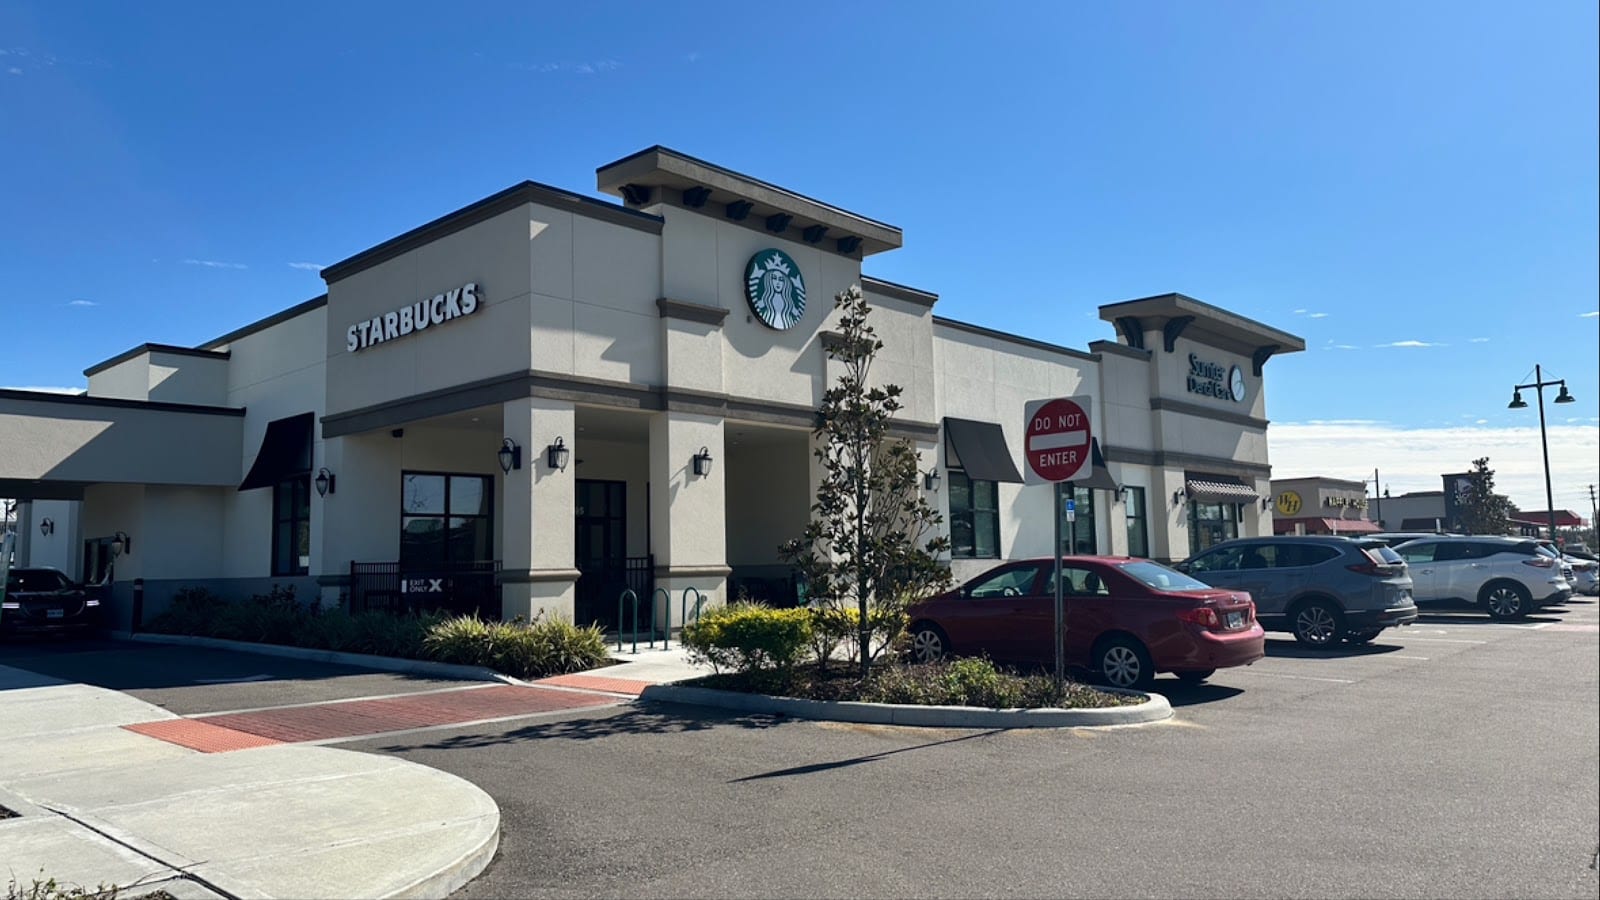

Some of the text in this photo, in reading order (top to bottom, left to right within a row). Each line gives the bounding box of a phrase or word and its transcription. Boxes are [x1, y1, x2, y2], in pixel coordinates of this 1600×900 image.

[347, 282, 478, 352] STARBUCKS
[1035, 413, 1081, 431] DO NOT
[1039, 451, 1077, 467] ENTER
[409, 585, 428, 593] ONLY
